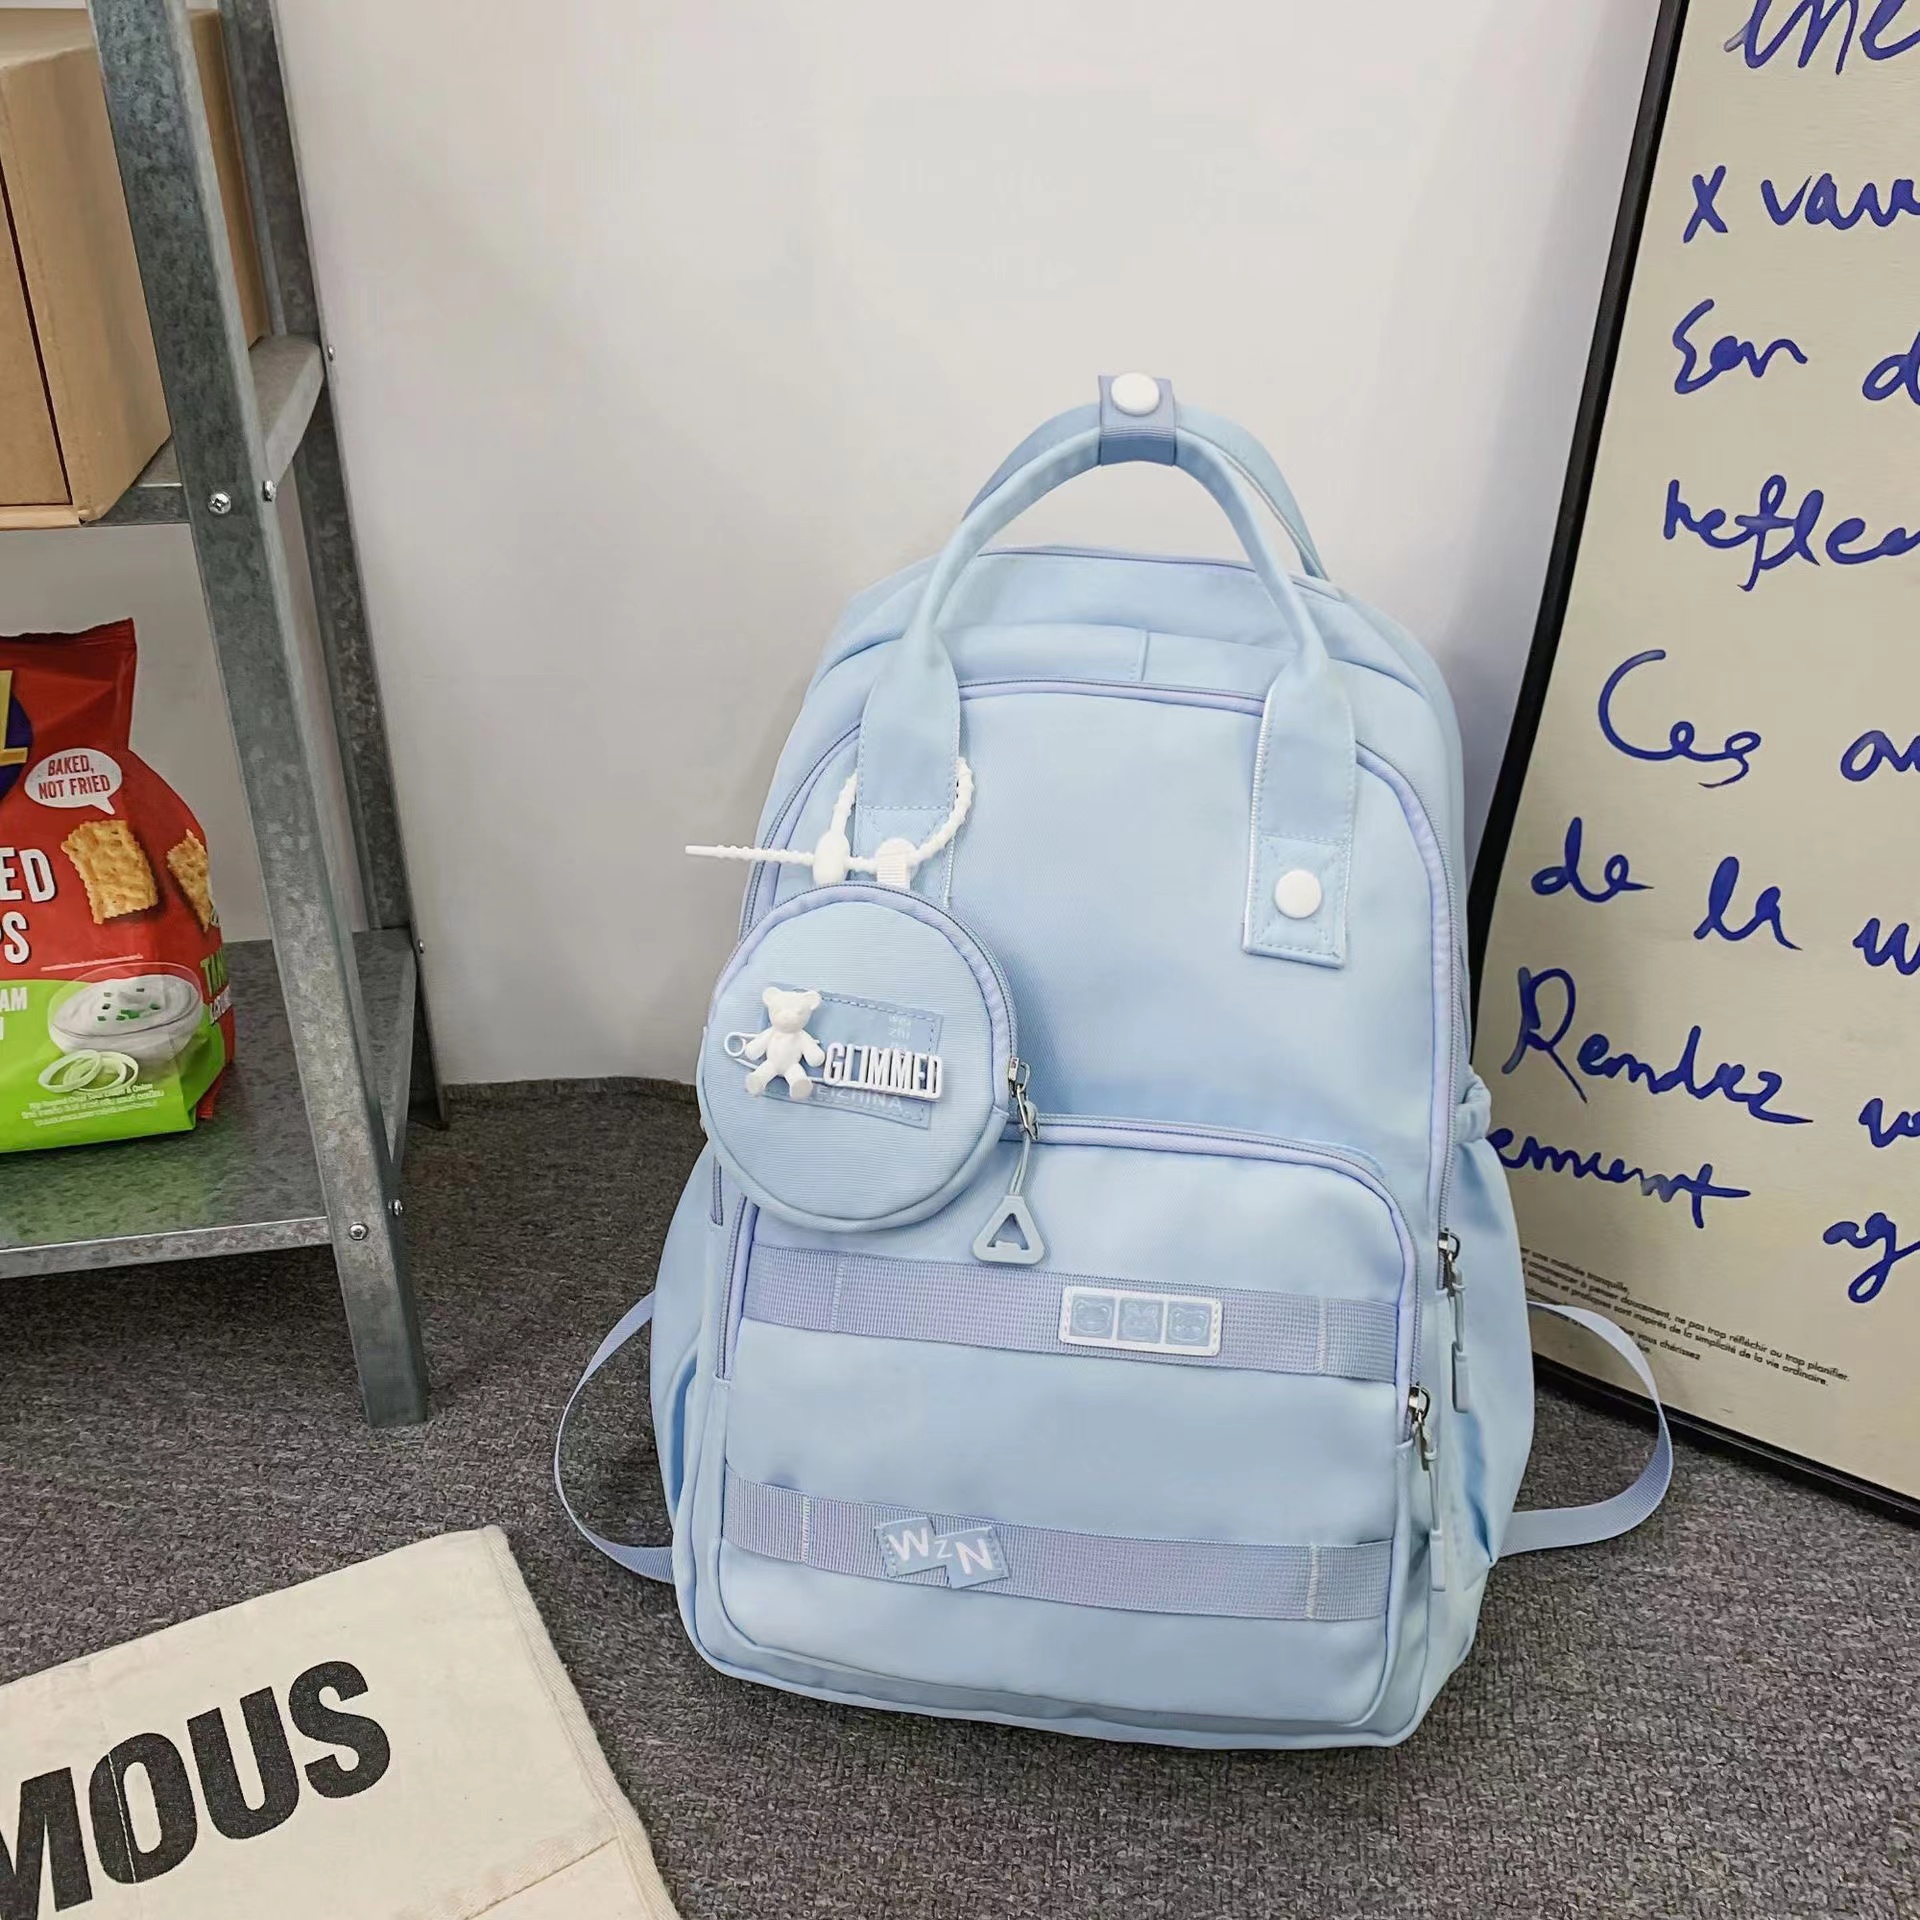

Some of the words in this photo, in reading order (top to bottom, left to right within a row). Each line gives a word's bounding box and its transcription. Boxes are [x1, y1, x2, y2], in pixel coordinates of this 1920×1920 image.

[38, 780, 64, 799] NOT
[69, 774, 111, 795] FRIED
[48, 755, 94, 776] BAKED,
[0, 911, 31, 965] S
[1669, 1324, 1681, 1335] de
[1683, 1328, 1693, 1339] la
[1739, 1348, 1751, 1359] de
[1754, 1352, 1763, 1363] la
[1766, 1359, 1780, 1369] vie
[1688, 1320, 1705, 1333] pas
[1707, 1326, 1727, 1340] trop
[1785, 1353, 1806, 1369] trop
[0, 1661, 391, 1920] MOUS
